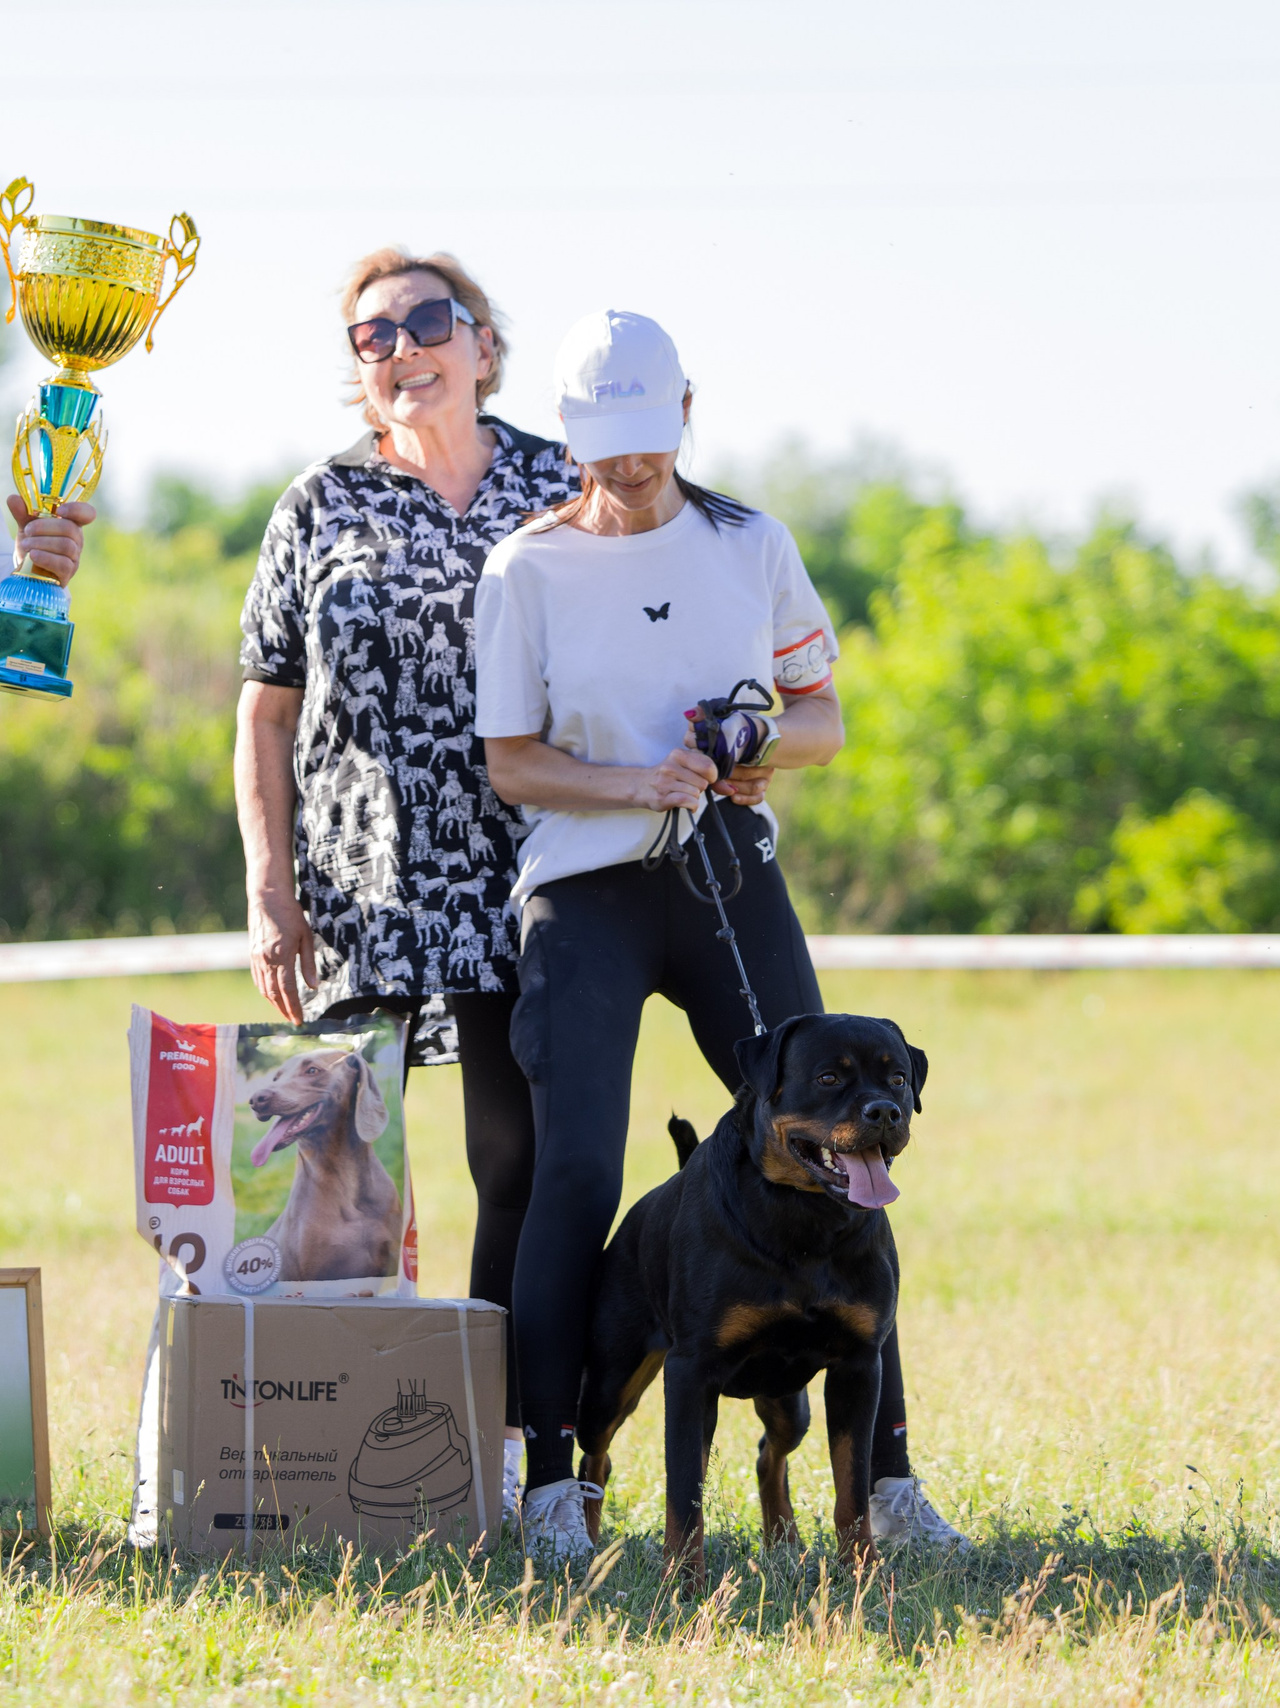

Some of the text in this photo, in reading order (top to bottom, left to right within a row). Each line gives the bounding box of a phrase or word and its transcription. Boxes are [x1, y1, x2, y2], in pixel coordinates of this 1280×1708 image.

[591, 377, 646, 403] FILA
[159, 1051, 210, 1067] PREMIUM
[172, 1063, 196, 1071] FOOD
[154, 1144, 206, 1165] ADULT
[170, 1167, 189, 1176] КОРМ
[153, 1176, 205, 1187] ДЛЯ ВЗРОСЛЫХ
[167, 1186, 190, 1196] СОБАК
[236, 1256, 273, 1275] 40%
